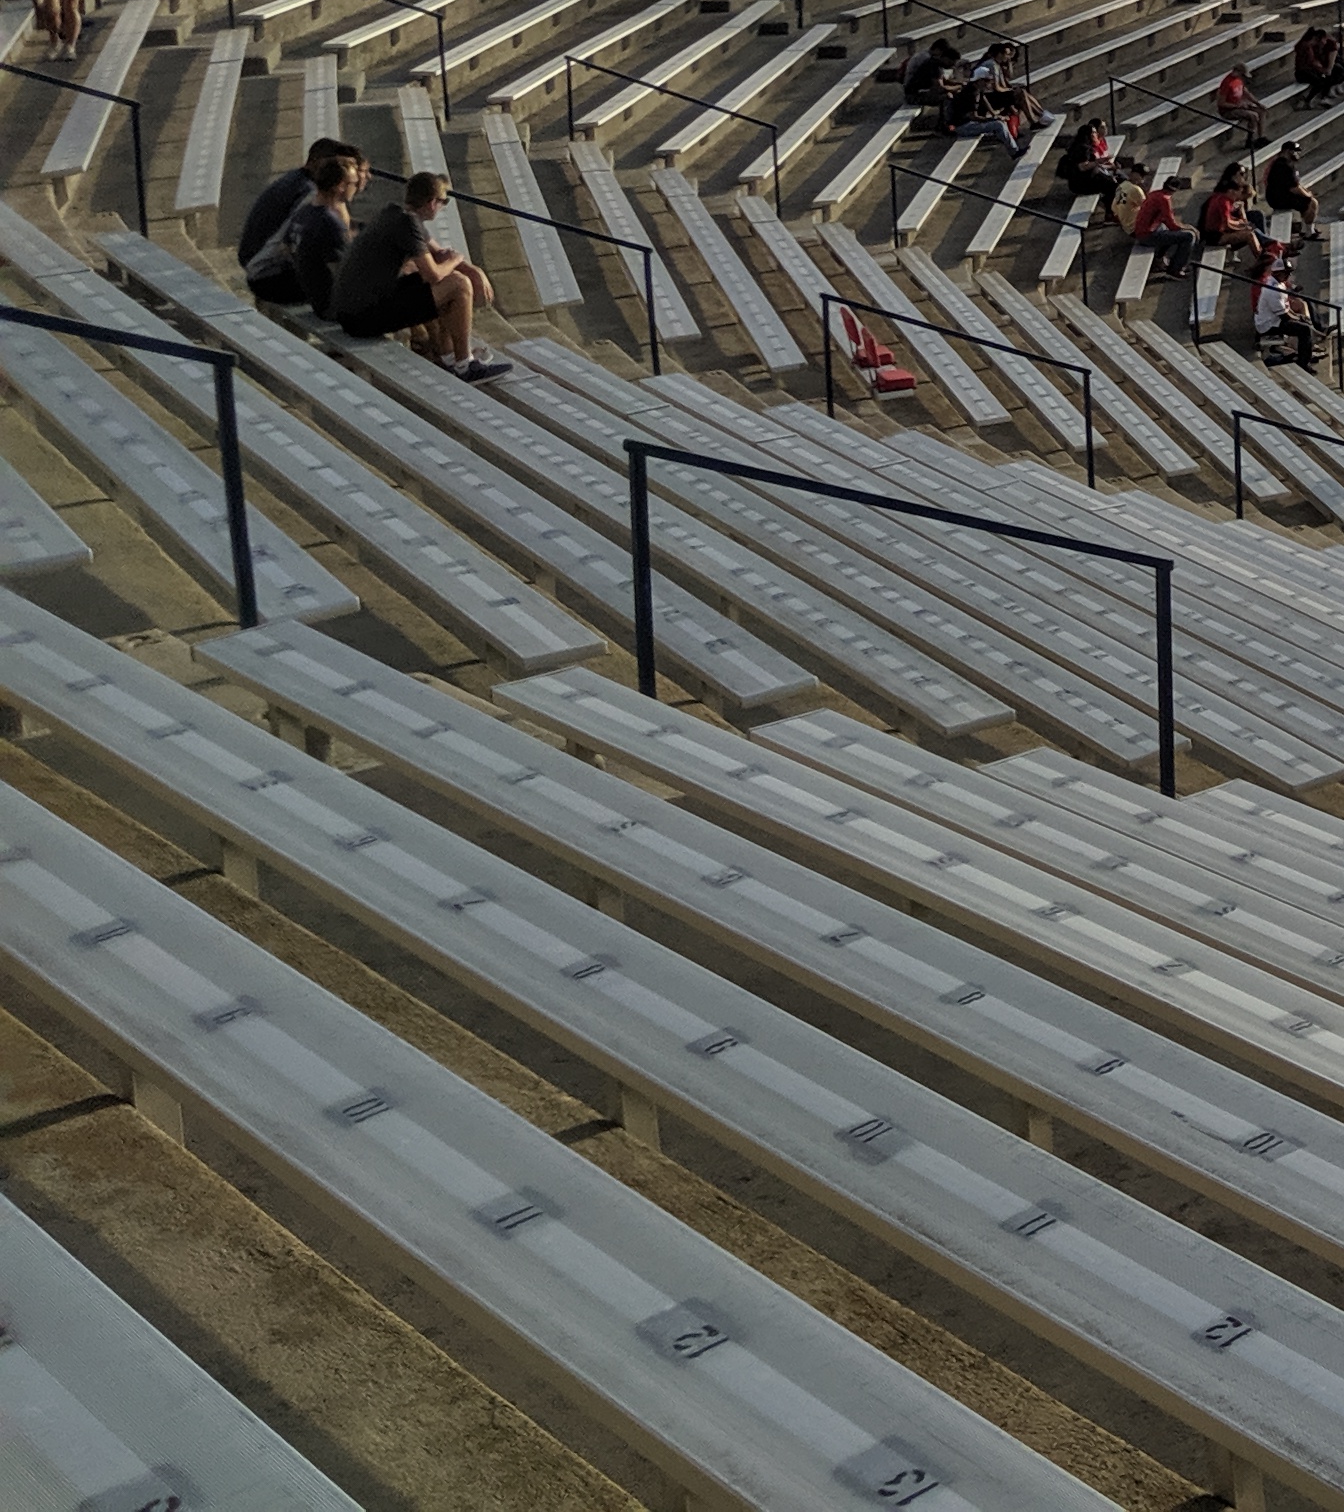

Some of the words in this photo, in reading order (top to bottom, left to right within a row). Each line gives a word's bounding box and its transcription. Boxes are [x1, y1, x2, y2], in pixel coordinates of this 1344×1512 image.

[494, 1204, 545, 1231] 11
[1017, 1212, 1057, 1236] 11
[672, 1324, 730, 1360] 12
[1205, 1316, 1252, 1349] 12
[876, 1469, 940, 1507] 13
